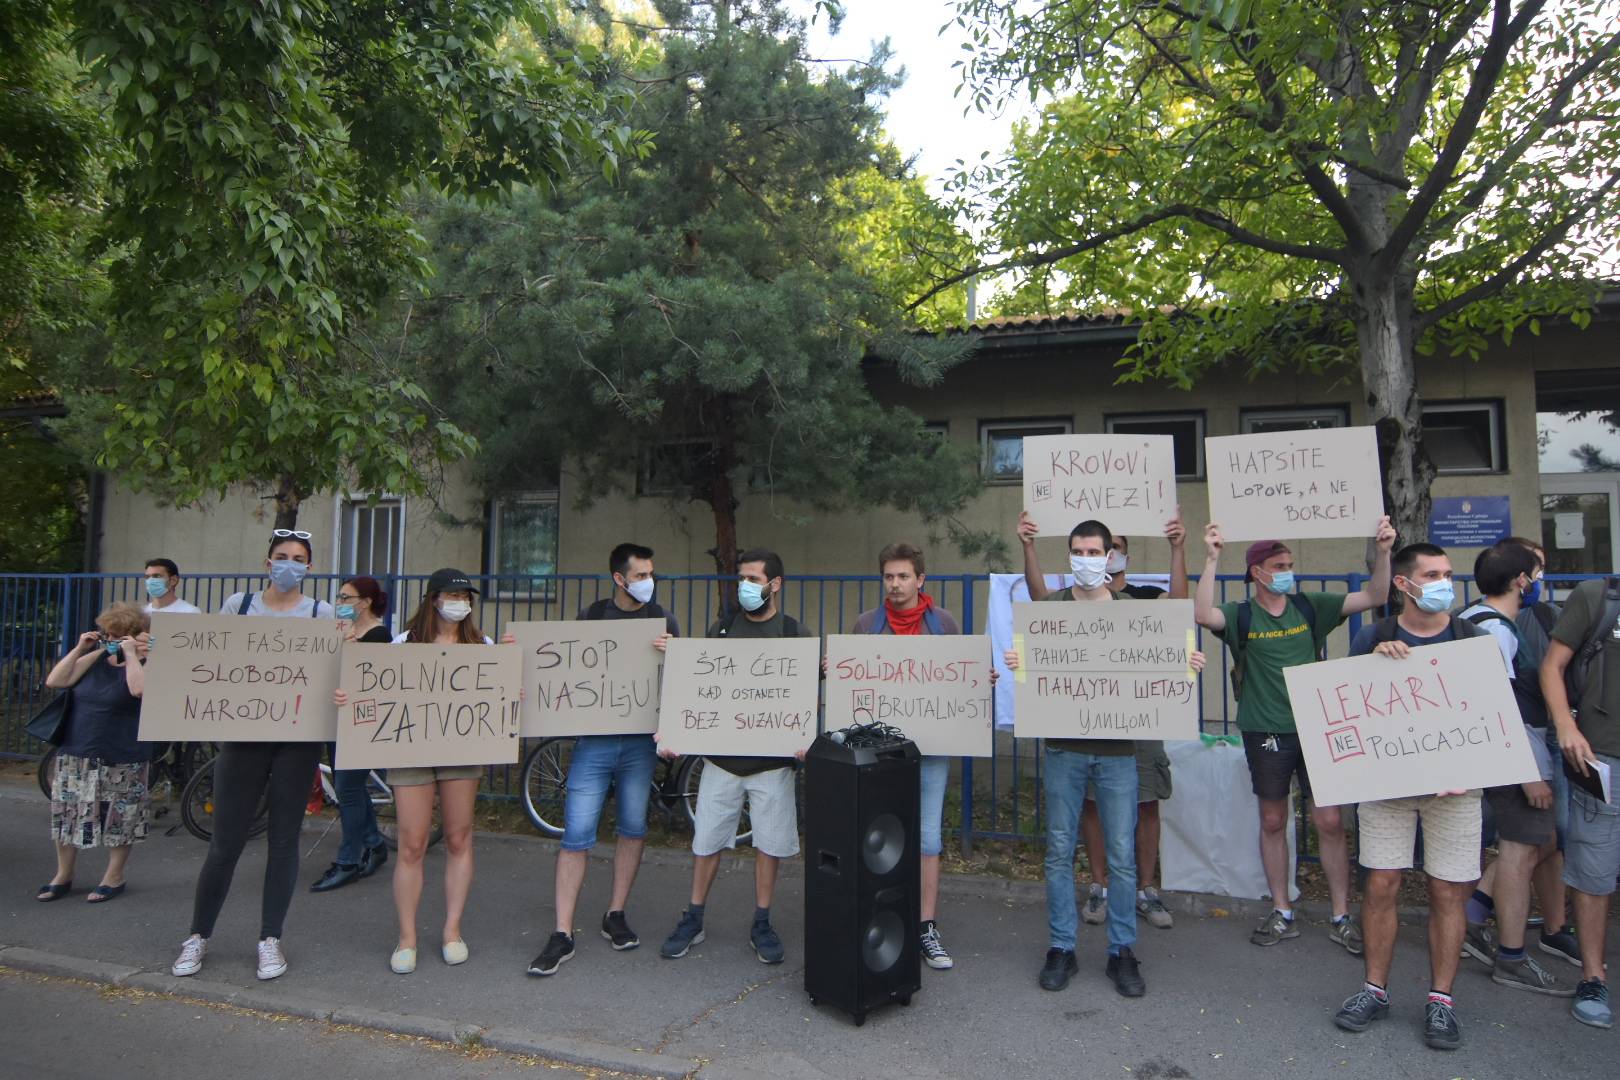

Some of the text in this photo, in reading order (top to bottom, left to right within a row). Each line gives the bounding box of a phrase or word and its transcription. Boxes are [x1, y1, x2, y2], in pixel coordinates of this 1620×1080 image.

[1036, 485, 1050, 497] NE
[1309, 482, 1318, 494] A
[1331, 480, 1348, 494] NE
[1284, 496, 1355, 521] BORCE!
[171, 631, 231, 651] SMRT
[536, 640, 617, 670] STOP
[694, 651, 797, 676] ŠTA ĆETE
[1032, 648, 1089, 665] РАНИЈЕ
[192, 663, 308, 686] SLOBODA
[698, 686, 790, 701] KAD OSTANETE
[1038, 676, 1194, 704] ПАНДУРИ ШЕТАЈУ
[184, 695, 302, 724] NARODU!
[357, 705, 375, 719] NE
[857, 694, 992, 728] NE BRUTALNOST!
[682, 710, 811, 736] BEZ SUZAVCA?
[1334, 734, 1358, 753] NE
